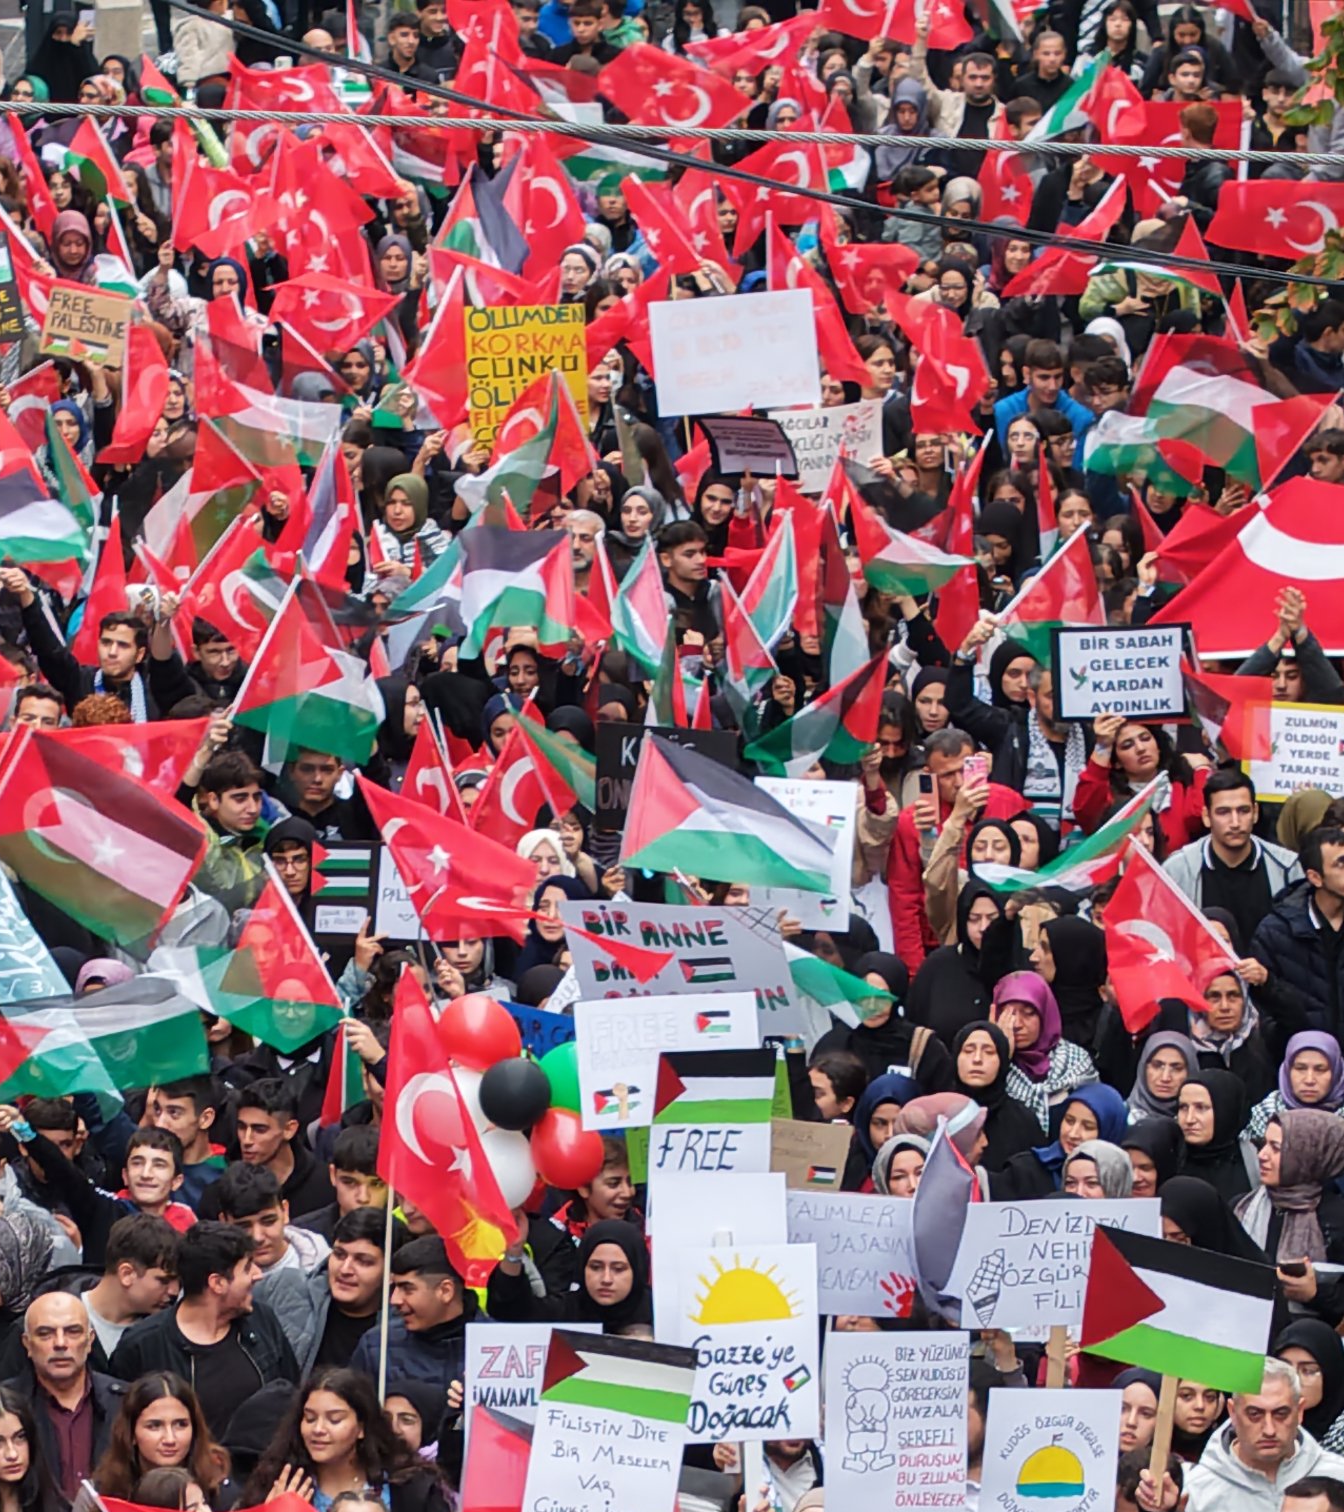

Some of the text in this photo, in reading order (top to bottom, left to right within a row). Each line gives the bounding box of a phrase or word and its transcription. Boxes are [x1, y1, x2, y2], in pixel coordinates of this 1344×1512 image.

[51, 291, 94, 315] FREE
[471, 332, 585, 355] KORKMA
[1080, 634, 1173, 650] BİR SABAH
[1090, 656, 1170, 671] GELECEK
[1092, 677, 1163, 693] KARDAN
[1090, 698, 1172, 714] AYDINLIK
[1284, 716, 1338, 730] ZULMÜN
[1289, 748, 1331, 761] YERDE
[1279, 764, 1340, 777] TARAFSIZ
[582, 905, 729, 949] BİR ANNE
[656, 1127, 744, 1171] FREE
[1003, 1263, 1090, 1287] ÖZGÜR
[895, 1368, 918, 1382] SEN
[708, 1371, 770, 1399] Güneş
[548, 1409, 624, 1437] FİLİSTİN
[1035, 1415, 1074, 1430] ÖZGÜR
[550, 1440, 580, 1463] BİR
[578, 1474, 616, 1499] VAR
[897, 1472, 916, 1486] BU
